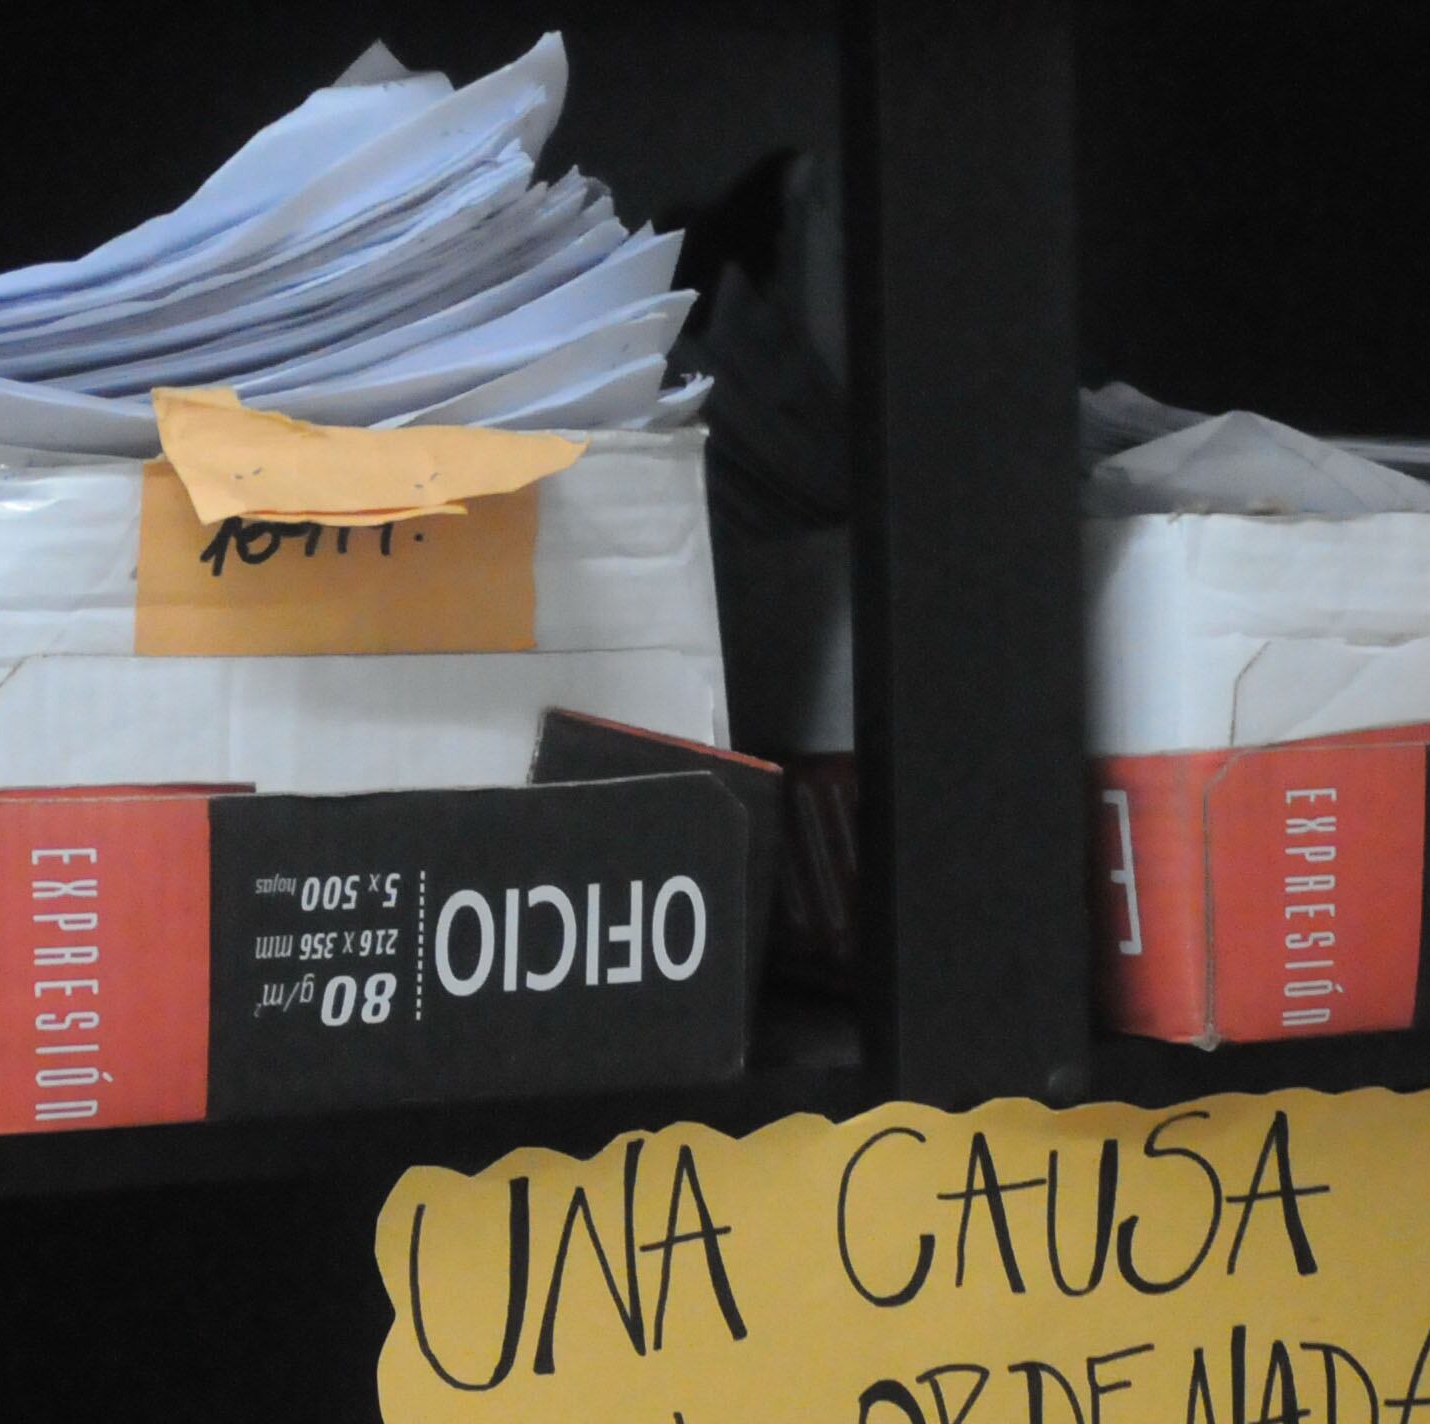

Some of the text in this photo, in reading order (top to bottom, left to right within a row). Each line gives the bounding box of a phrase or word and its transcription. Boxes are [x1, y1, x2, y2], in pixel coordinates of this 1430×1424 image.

[255, 875, 296, 894] hojas
[302, 875, 360, 912] 500
[383, 873, 401, 908] 5
[256, 935, 294, 960] mm
[300, 932, 336, 961] 356
[360, 929, 399, 957] 216
[434, 875, 707, 997] OFICIO
[321, 973, 397, 1027] 80
[409, 1110, 1331, 1392] UNA CAUSA
